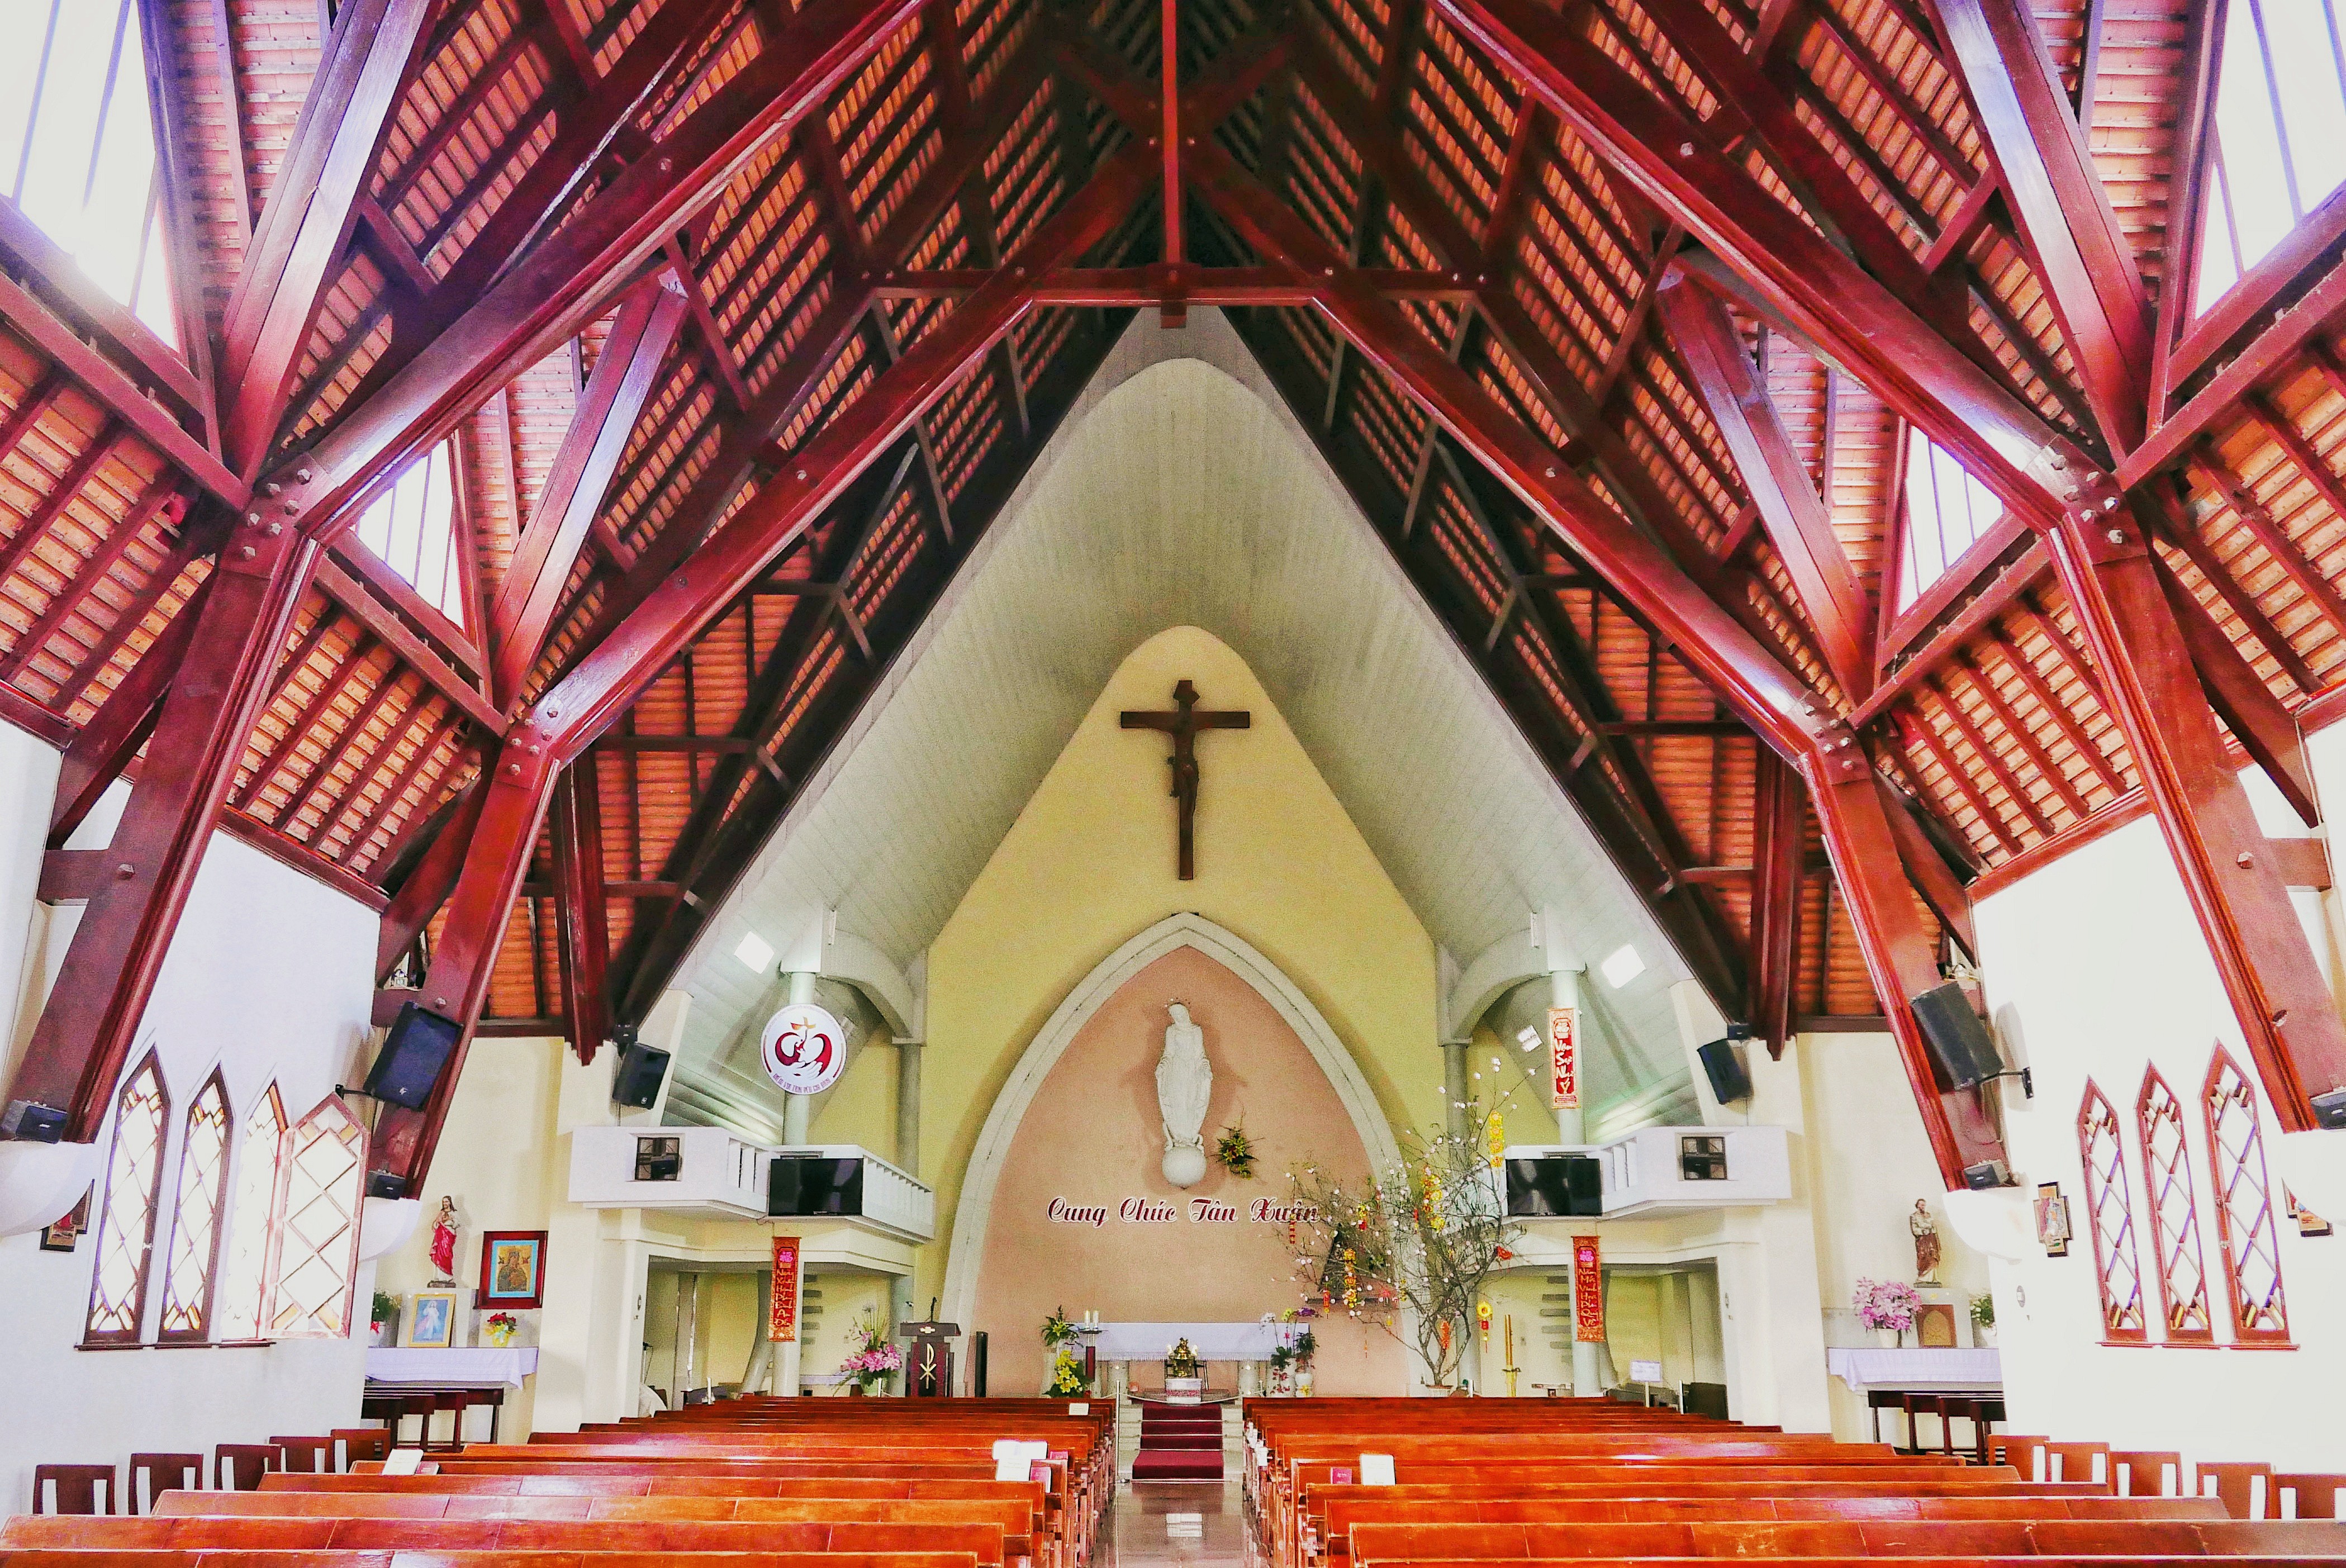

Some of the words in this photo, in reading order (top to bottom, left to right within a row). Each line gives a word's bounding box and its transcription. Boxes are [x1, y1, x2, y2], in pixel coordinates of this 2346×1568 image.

[1560, 1077, 1570, 1094] Ý
[1048, 1197, 1108, 1227] Cung
[1120, 1197, 1176, 1223] Chúc
[1189, 1198, 1238, 1223] Tân
